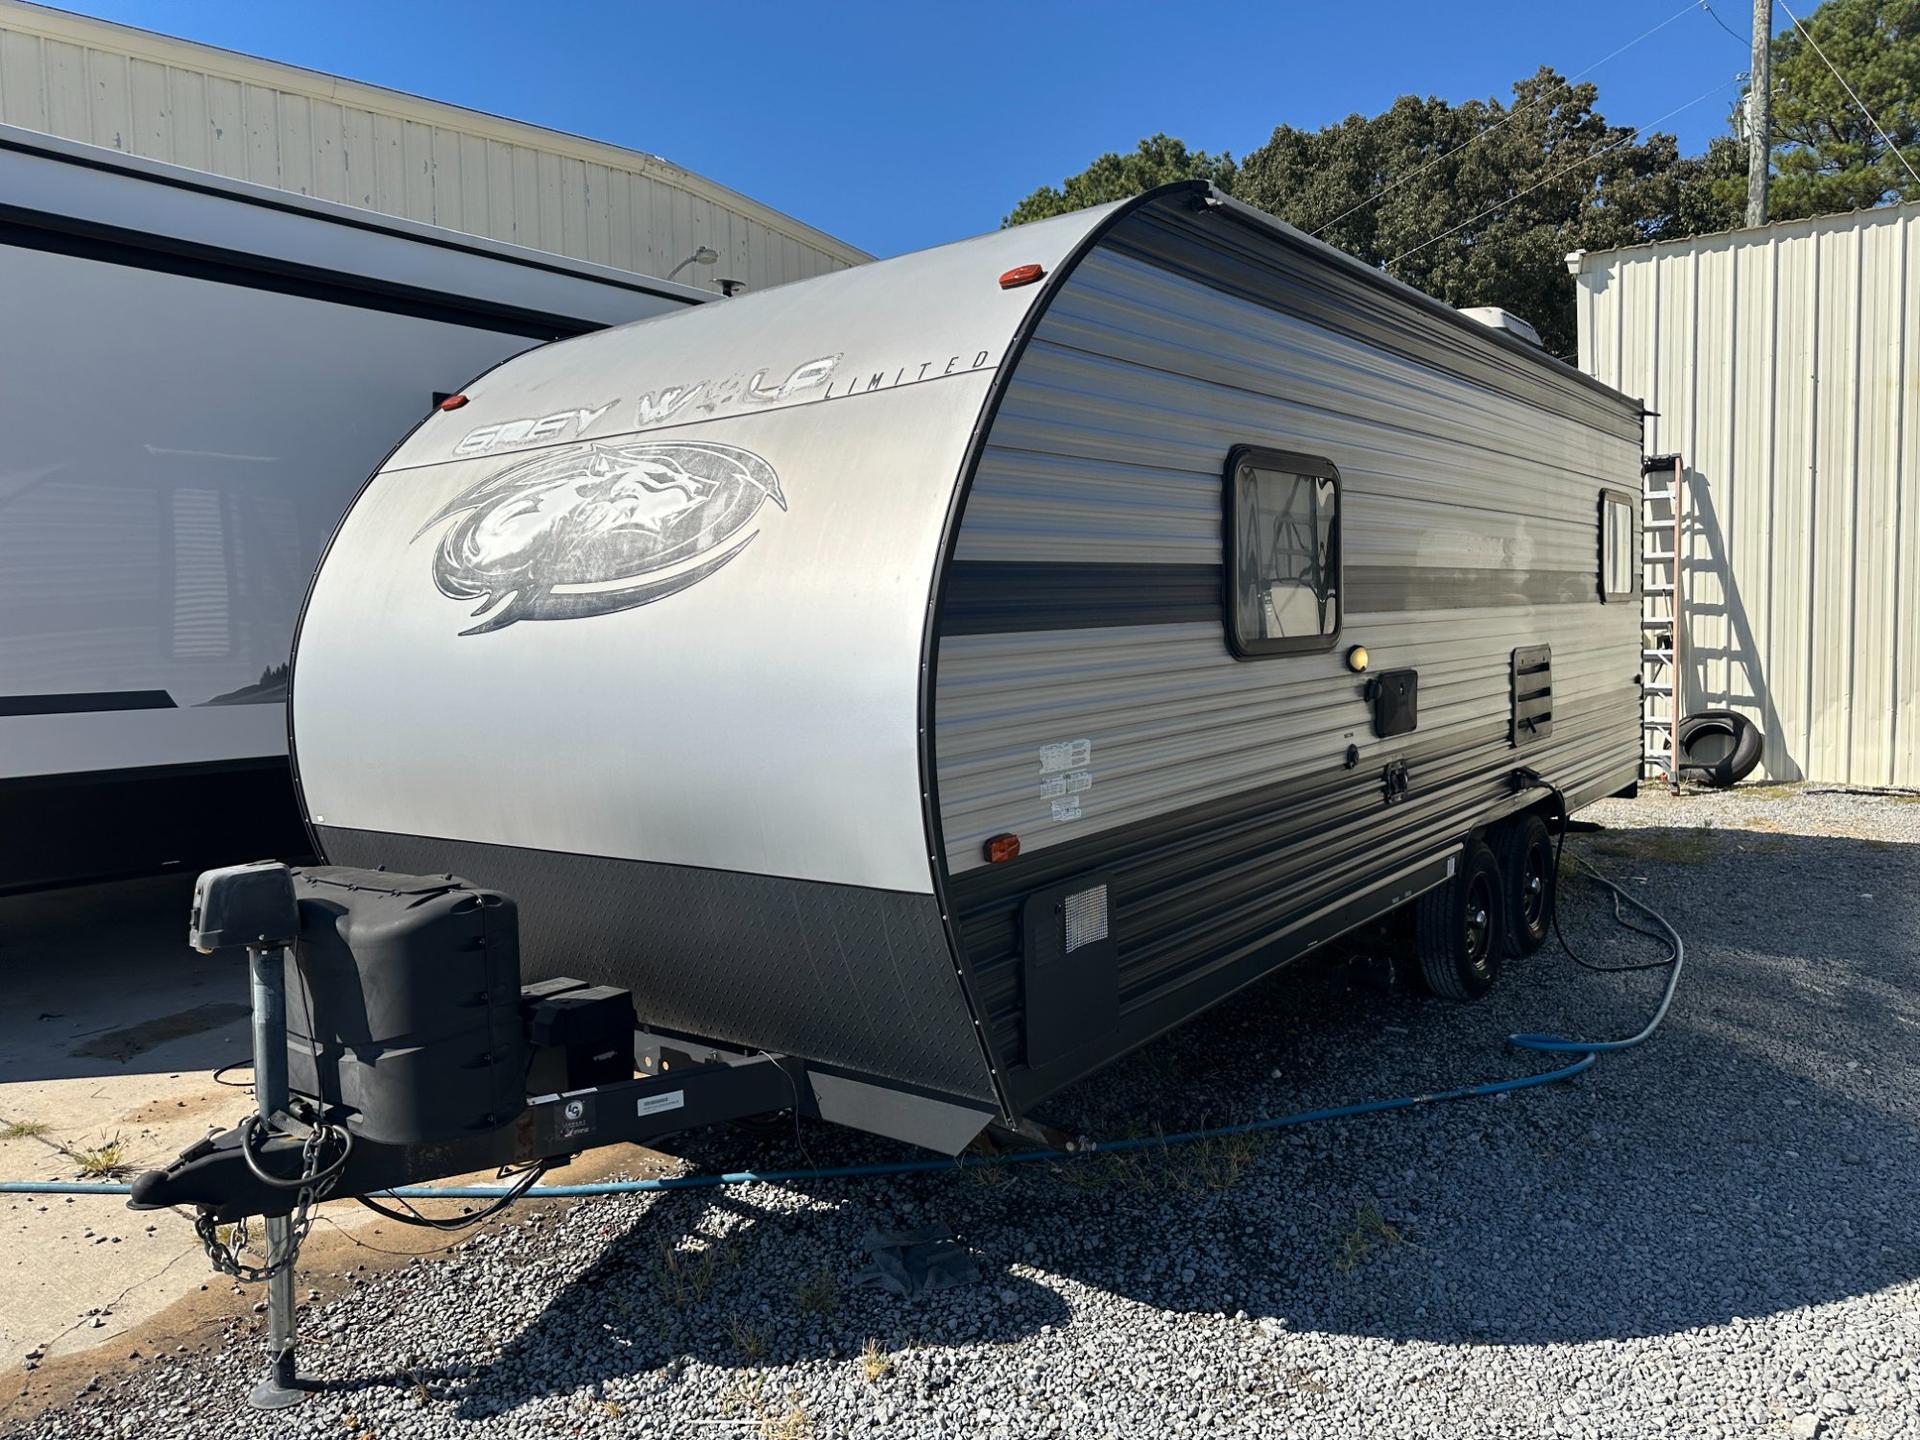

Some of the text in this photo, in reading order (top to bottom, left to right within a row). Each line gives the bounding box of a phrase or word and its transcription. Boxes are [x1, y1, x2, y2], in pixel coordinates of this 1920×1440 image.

[453, 352, 844, 455] GREY WLF
[824, 350, 988, 400] LIMITED
